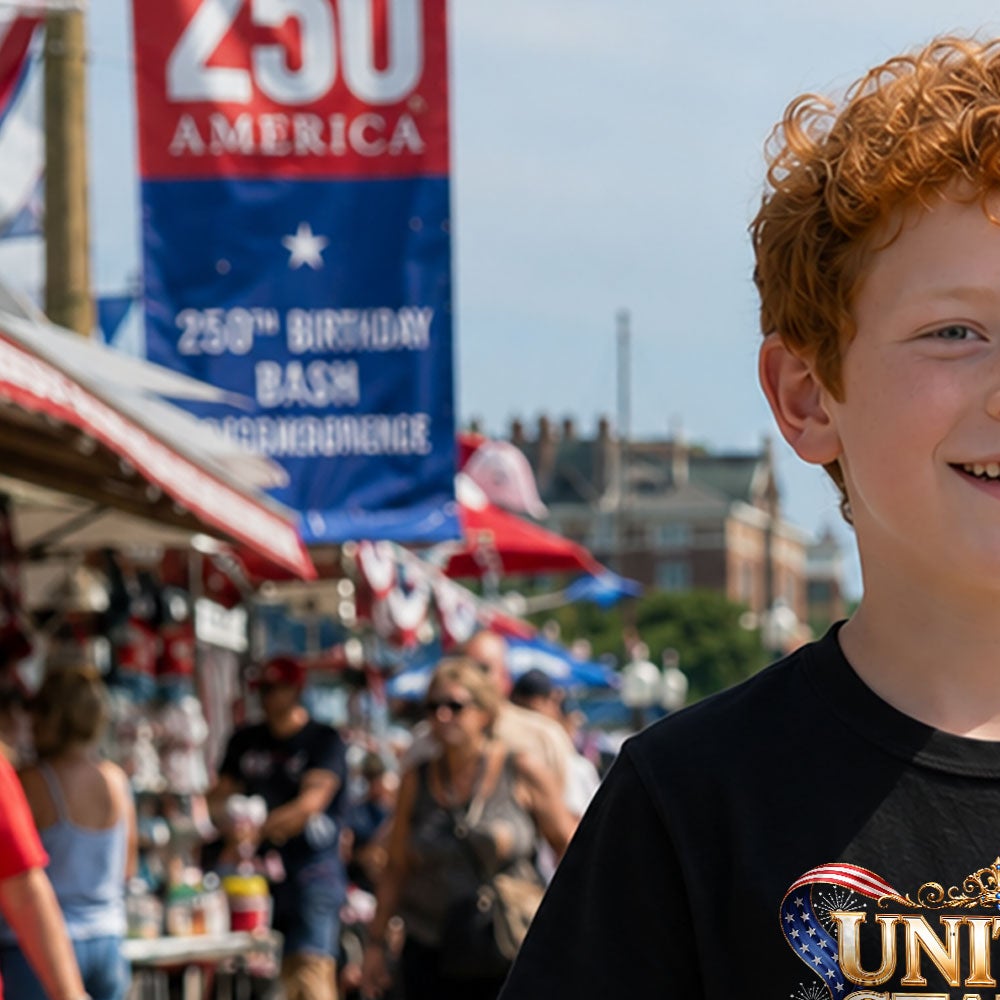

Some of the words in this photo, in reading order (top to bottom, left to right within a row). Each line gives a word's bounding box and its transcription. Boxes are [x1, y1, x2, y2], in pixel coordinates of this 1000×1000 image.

[165, 0, 424, 105] 250
[168, 112, 425, 157] AMERICA
[286, 306, 434, 354] BIRTHDAY
[255, 360, 360, 408] BASH
